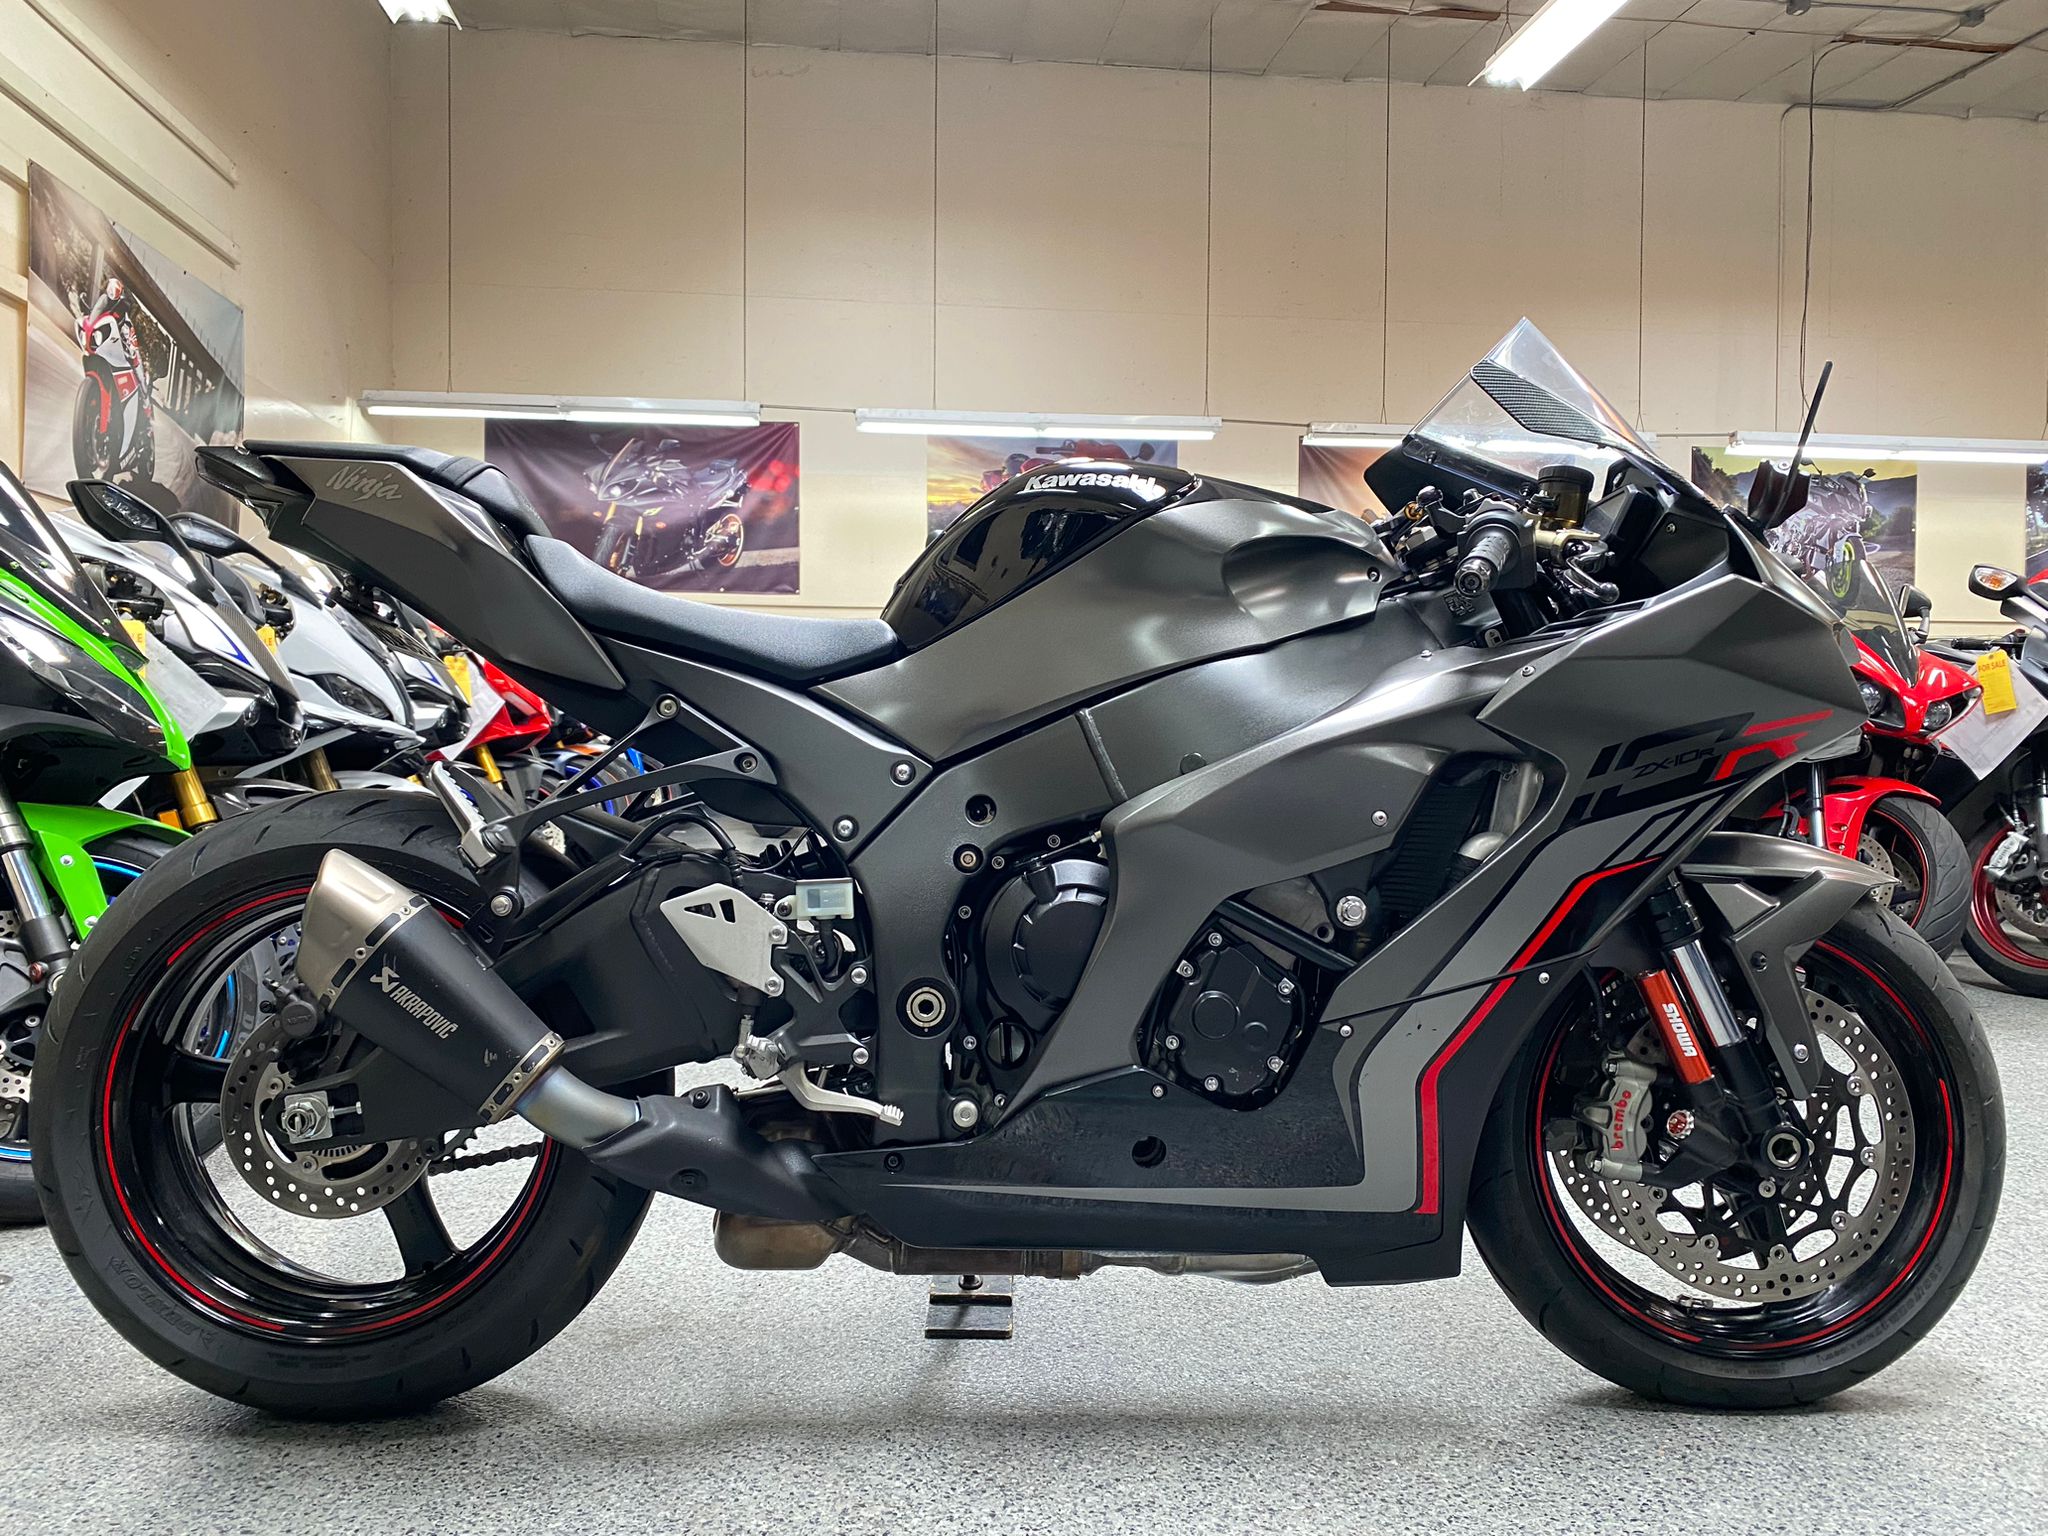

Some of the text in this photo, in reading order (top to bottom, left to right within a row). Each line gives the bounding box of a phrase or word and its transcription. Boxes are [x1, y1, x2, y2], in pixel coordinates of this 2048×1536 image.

[326, 465, 402, 502] Ninja
[1024, 473, 1163, 497] Kawasaki
[1978, 659, 2007, 672] FOR SALE
[1632, 747, 1716, 779] ZX-10R
[1662, 1002, 1698, 1057] SHOWA
[1610, 1090, 1632, 1151] brembo
